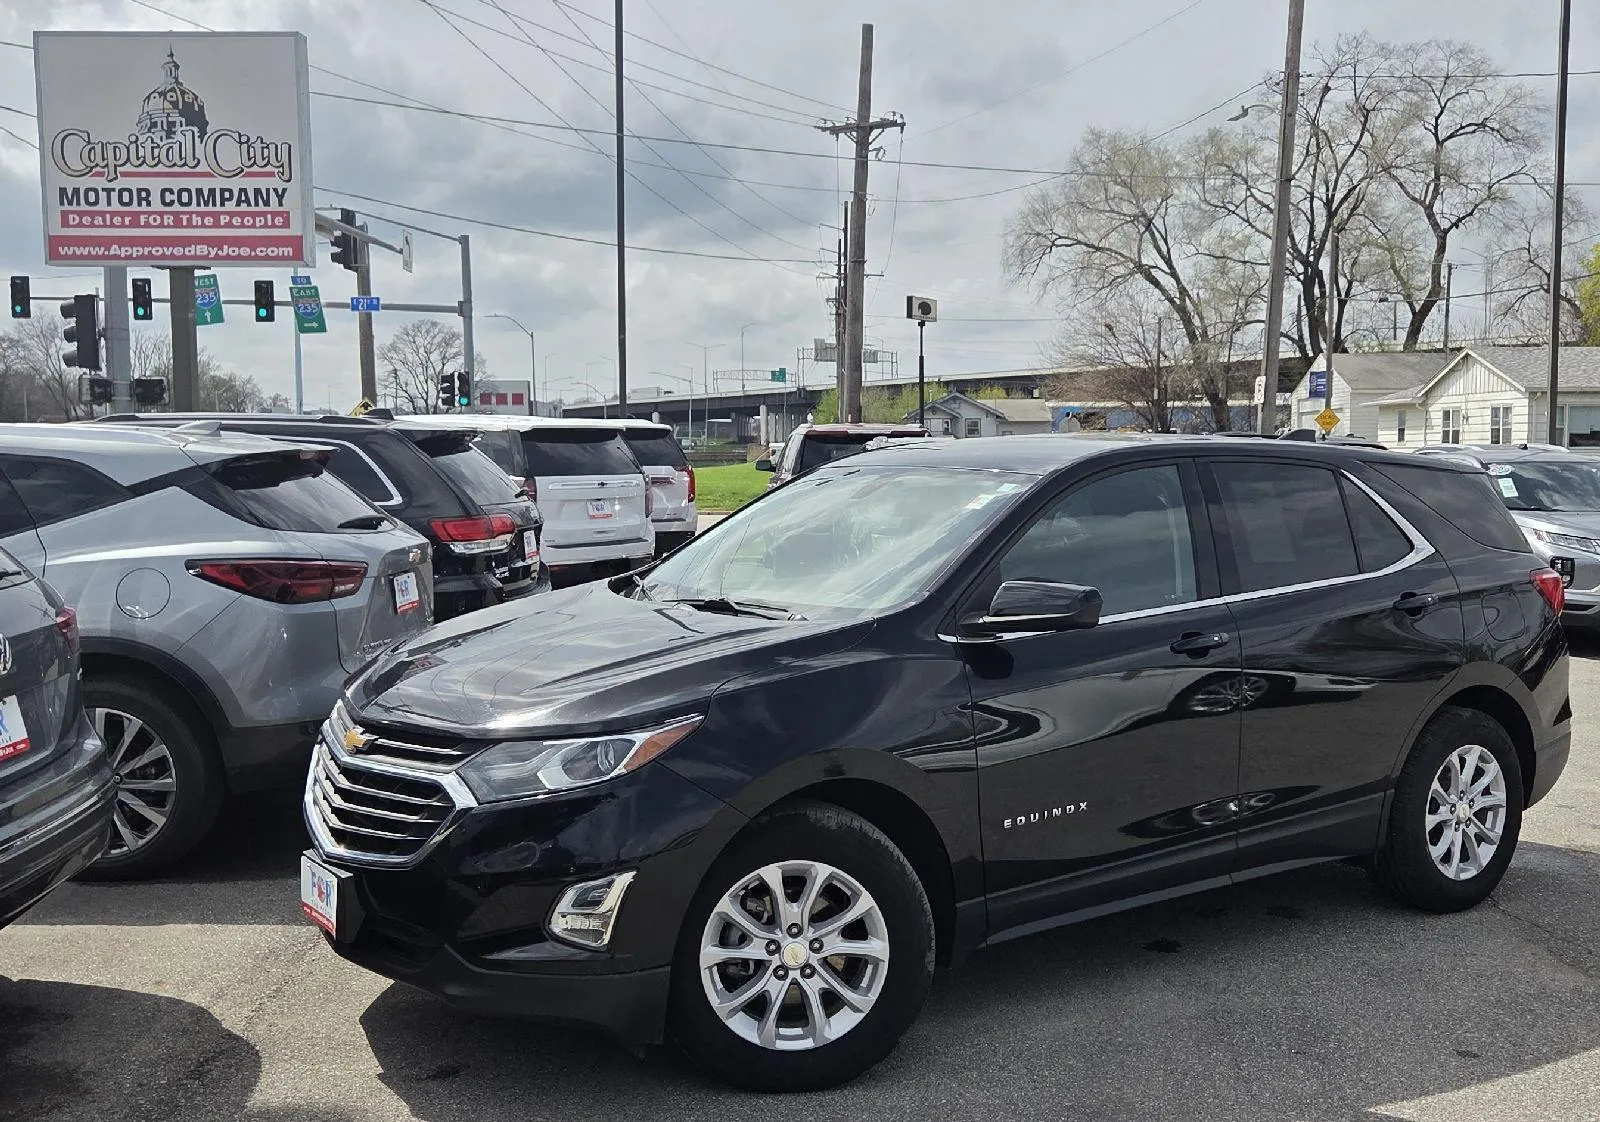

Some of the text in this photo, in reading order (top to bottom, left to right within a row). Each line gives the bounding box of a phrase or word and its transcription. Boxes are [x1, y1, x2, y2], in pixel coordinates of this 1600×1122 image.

[51, 128, 293, 182] Capital City
[59, 187, 288, 207] MOTOR COMPANY
[68, 213, 284, 227] Dealer FOR The People
[58, 243, 293, 258] www.ApprovedByJoe.com
[196, 292, 216, 304] 235
[292, 288, 316, 297] EAST
[298, 303, 319, 313] 235
[1003, 801, 1088, 829] EQUINOX
